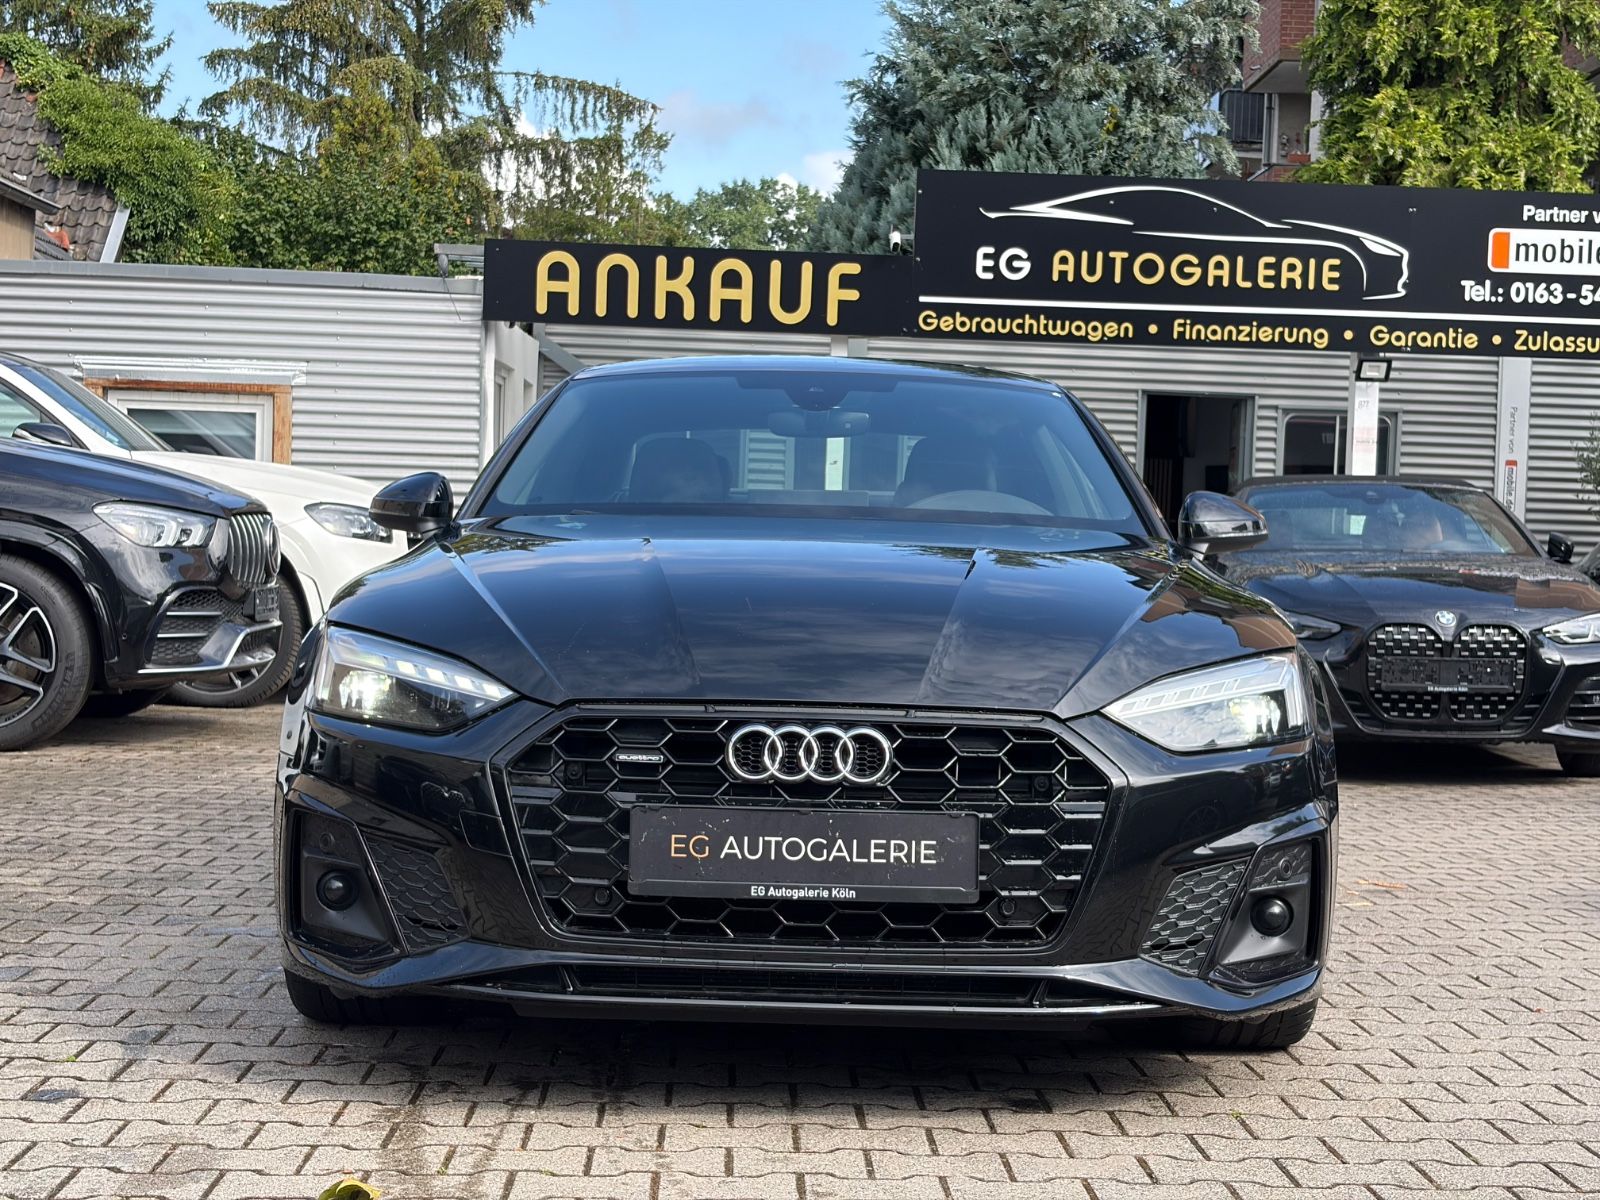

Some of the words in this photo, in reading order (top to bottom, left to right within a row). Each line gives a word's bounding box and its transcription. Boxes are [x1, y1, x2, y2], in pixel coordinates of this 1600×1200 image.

[1522, 204, 1589, 223] Partner
[975, 246, 1031, 281] EG
[1052, 250, 1341, 291] AUTOGALERIE
[535, 250, 862, 327] ANKAUF
[1460, 279, 1504, 303] Tel.:
[918, 310, 1134, 342] Gebrauchtwagen
[1173, 319, 1329, 349] Finanzierung
[1369, 325, 1479, 349] Garantie
[1514, 329, 1600, 353] Zulassu
[1509, 406, 1518, 437] Partner
[670, 834, 710, 858] EG
[720, 835, 938, 864] AUTOGALERIE
[750, 886, 766, 897] EG
[768, 886, 829, 899] Autogalerie
[832, 888, 856, 899] Köln
